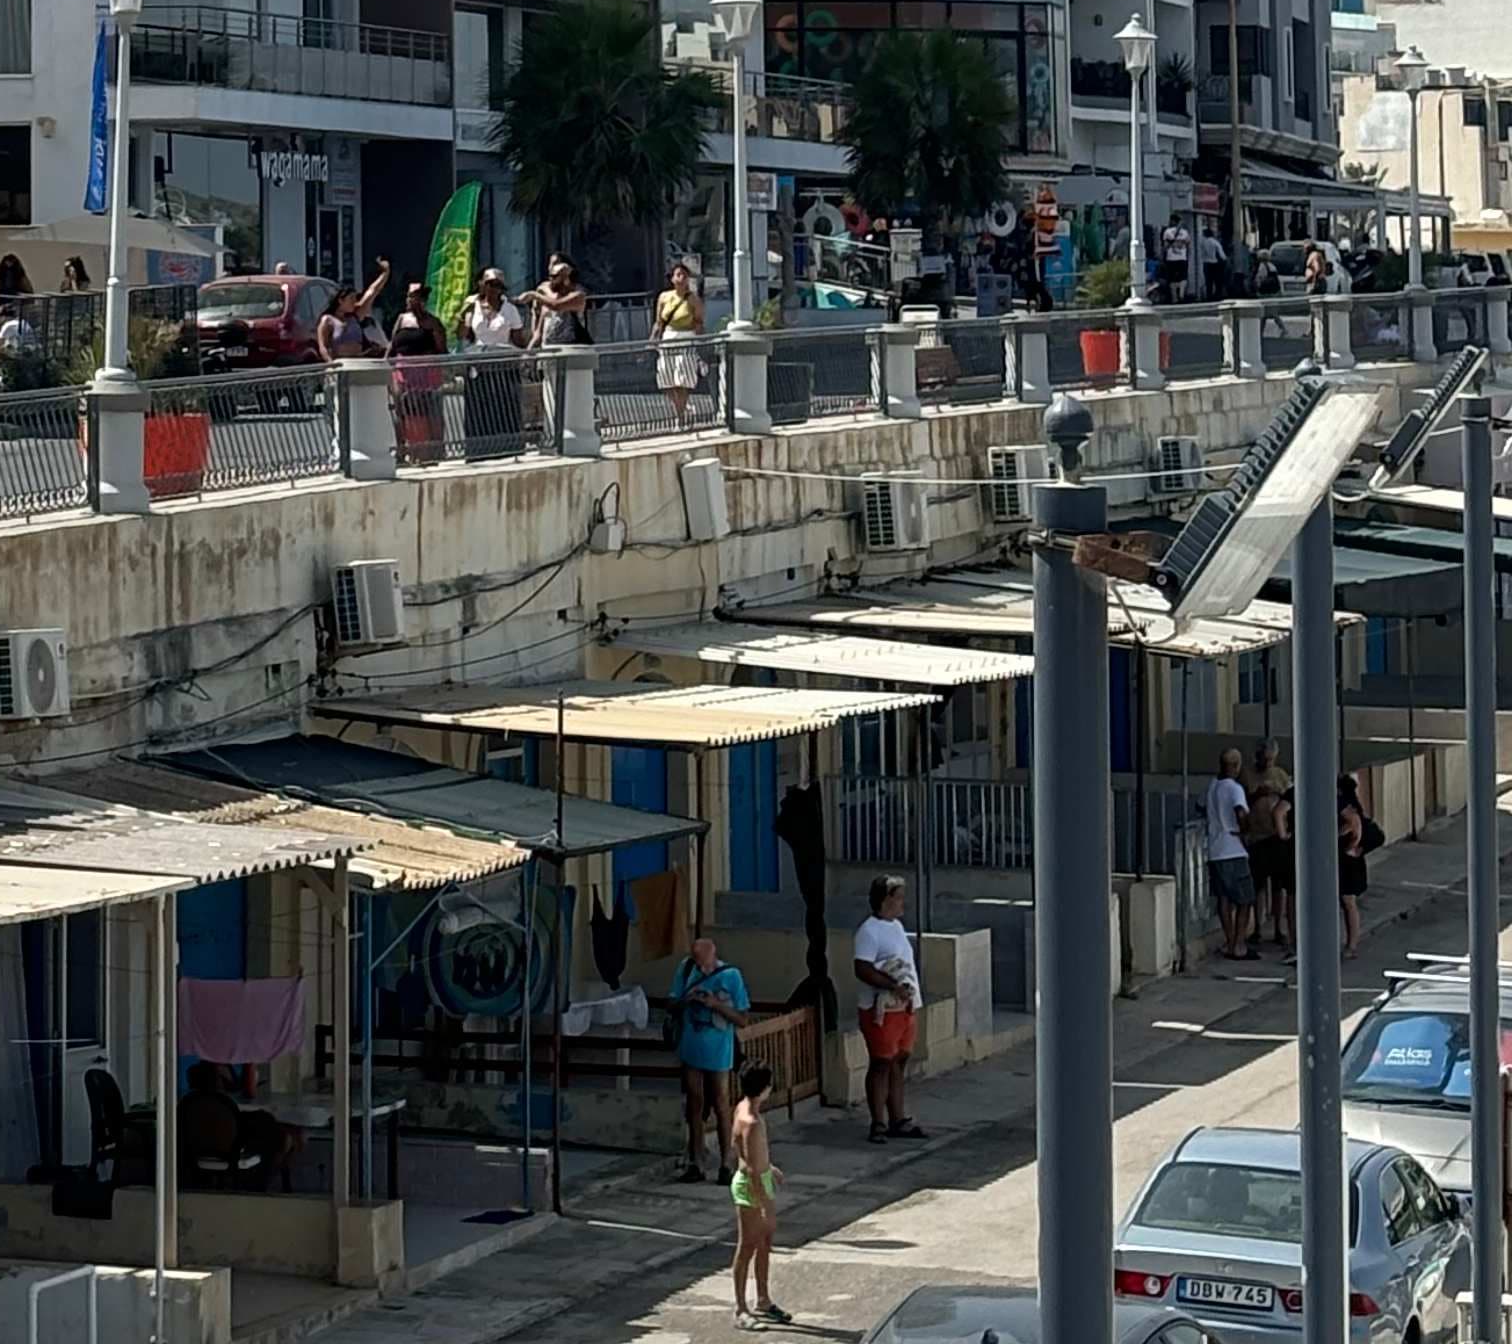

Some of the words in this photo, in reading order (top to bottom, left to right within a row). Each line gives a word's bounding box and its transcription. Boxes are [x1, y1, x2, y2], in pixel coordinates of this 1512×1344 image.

[260, 151, 329, 188] wagamama
[1190, 1280, 1225, 1299] DBW
[1232, 1285, 1267, 1305] 745
